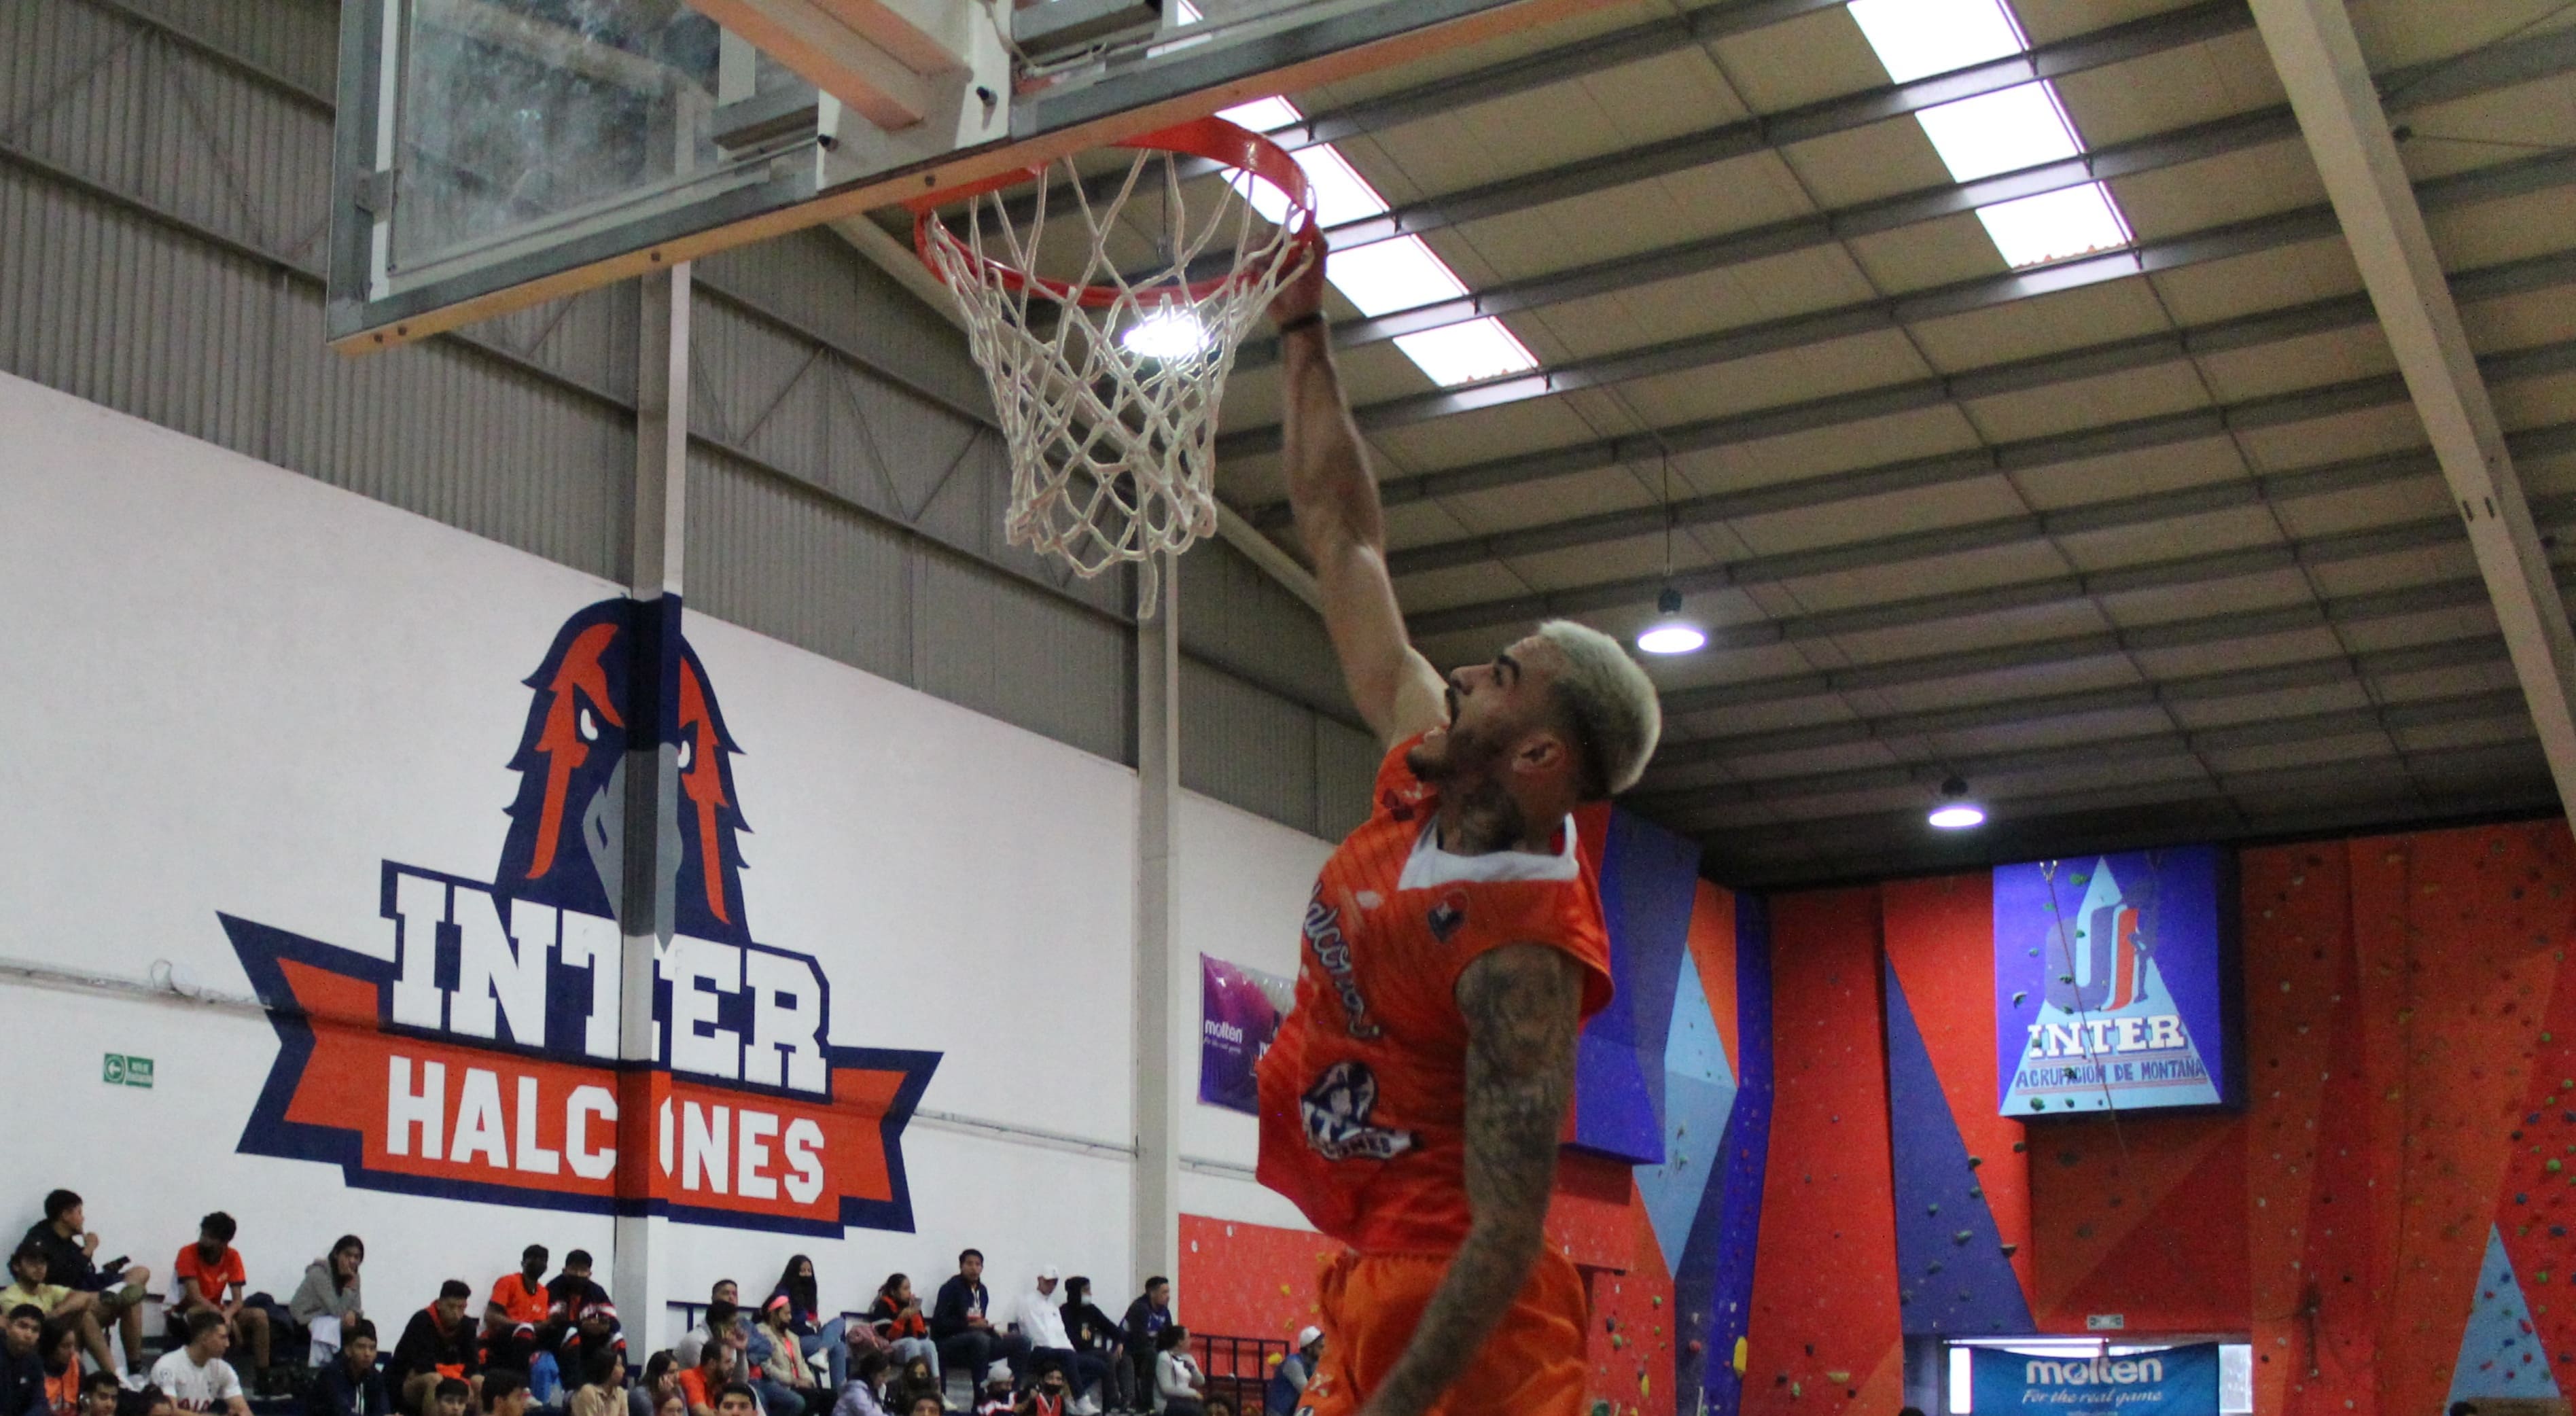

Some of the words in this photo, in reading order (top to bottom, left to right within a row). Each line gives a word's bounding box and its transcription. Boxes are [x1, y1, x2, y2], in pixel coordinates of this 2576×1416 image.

[393, 872, 826, 1095] INTER
[1205, 1019, 1243, 1044] molten
[2027, 1014, 2186, 1058] INTER
[2114, 1062, 2133, 1082] DE
[2026, 1358, 2163, 1385] molten
[2022, 1388, 2048, 1404] For
[2050, 1388, 2077, 1404] the
[2079, 1388, 2115, 1404] real
[2115, 1390, 2162, 1408] game
